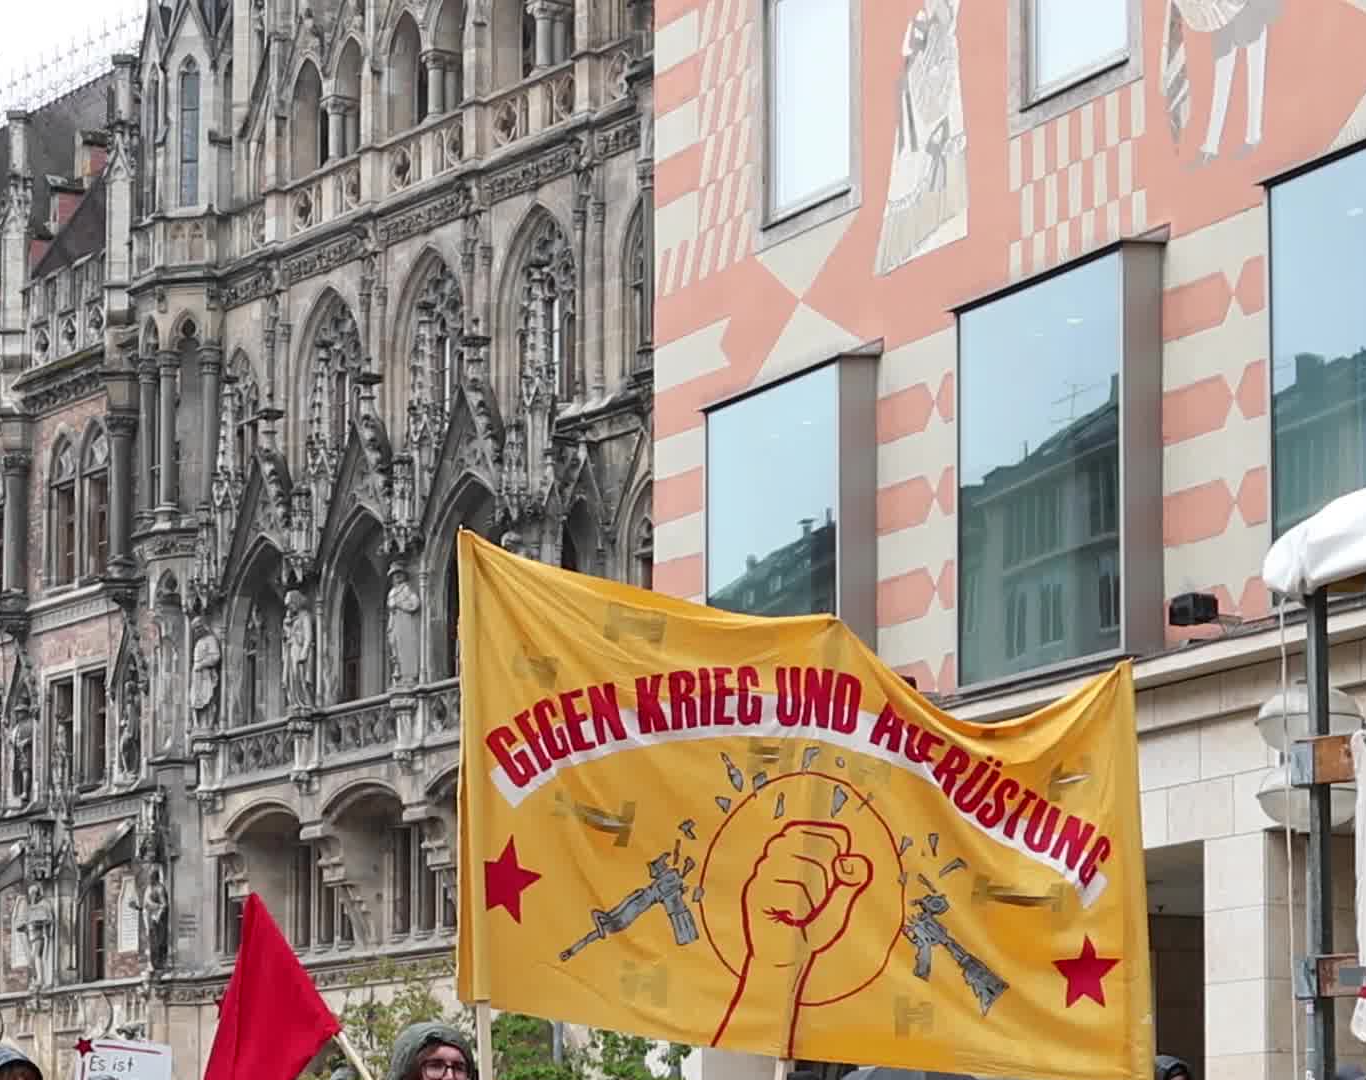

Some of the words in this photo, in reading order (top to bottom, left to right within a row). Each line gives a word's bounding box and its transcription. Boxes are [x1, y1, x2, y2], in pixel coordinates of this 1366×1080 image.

[485, 682, 627, 790] GEGEN
[634, 665, 763, 735] KRIEG
[776, 666, 862, 736] UND
[89, 1055, 107, 1072] Es
[113, 1056, 134, 1073] ist
